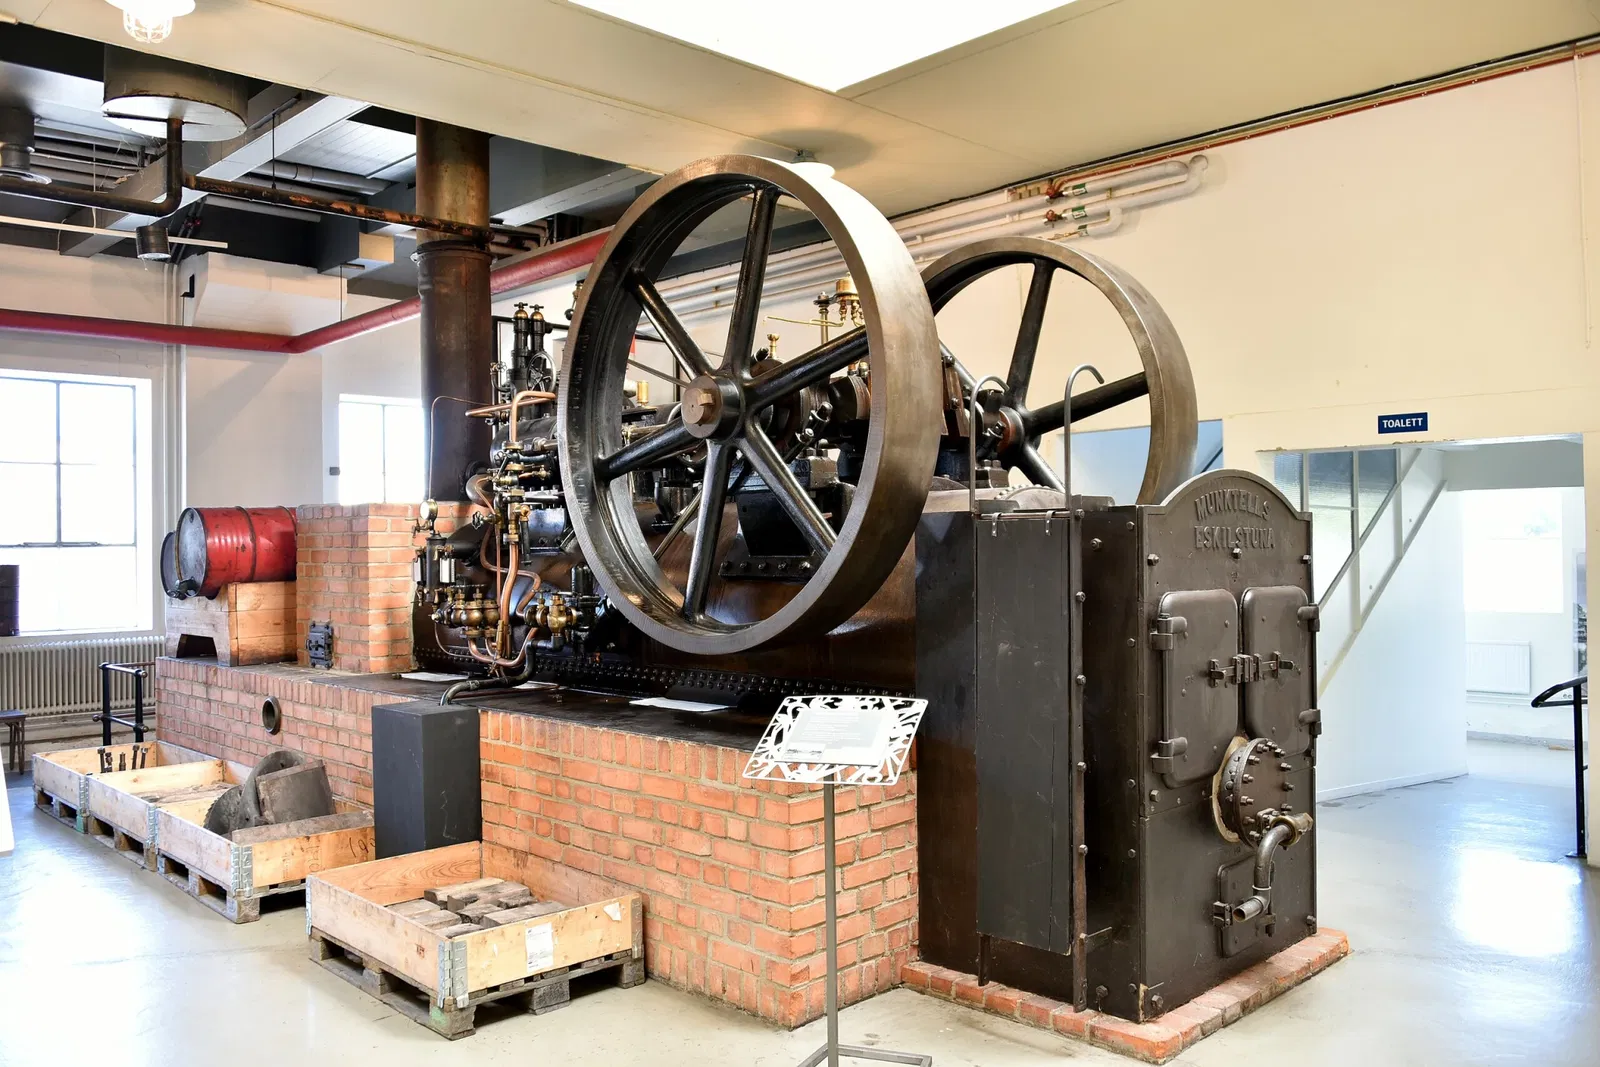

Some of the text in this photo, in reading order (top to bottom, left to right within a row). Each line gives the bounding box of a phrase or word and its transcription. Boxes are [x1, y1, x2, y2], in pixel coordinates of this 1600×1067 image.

[1382, 417, 1423, 428] TOALETT
[1195, 488, 1271, 521] MUNKTELLS
[1195, 525, 1276, 550] ESKILSTUNA
